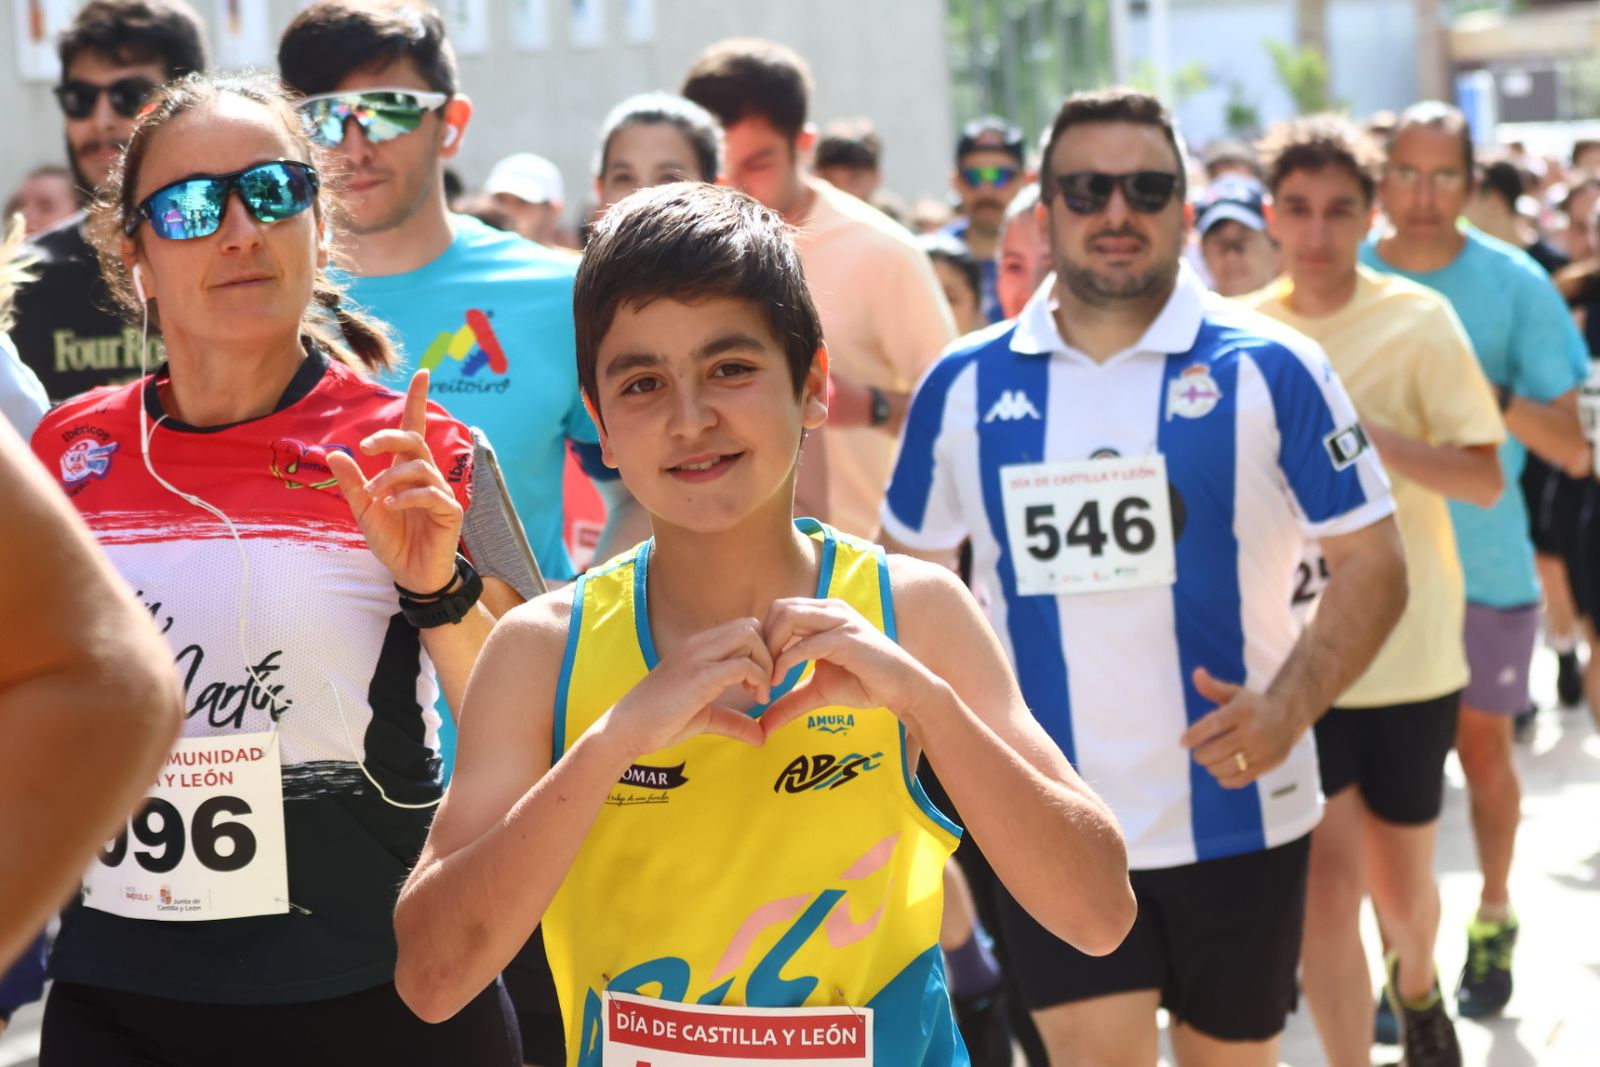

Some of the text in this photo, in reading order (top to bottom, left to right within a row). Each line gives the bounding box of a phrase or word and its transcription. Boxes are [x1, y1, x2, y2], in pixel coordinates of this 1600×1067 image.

[1035, 476, 1050, 488] DE
[1053, 472, 1109, 486] CASTILLA
[1024, 496, 1156, 563] 546
[807, 714, 855, 730] AMURA
[165, 774, 175, 788] Y
[181, 769, 233, 788] LEÓN
[616, 1010, 857, 1046] DÍA DE CASTILLA Y LEÓN
